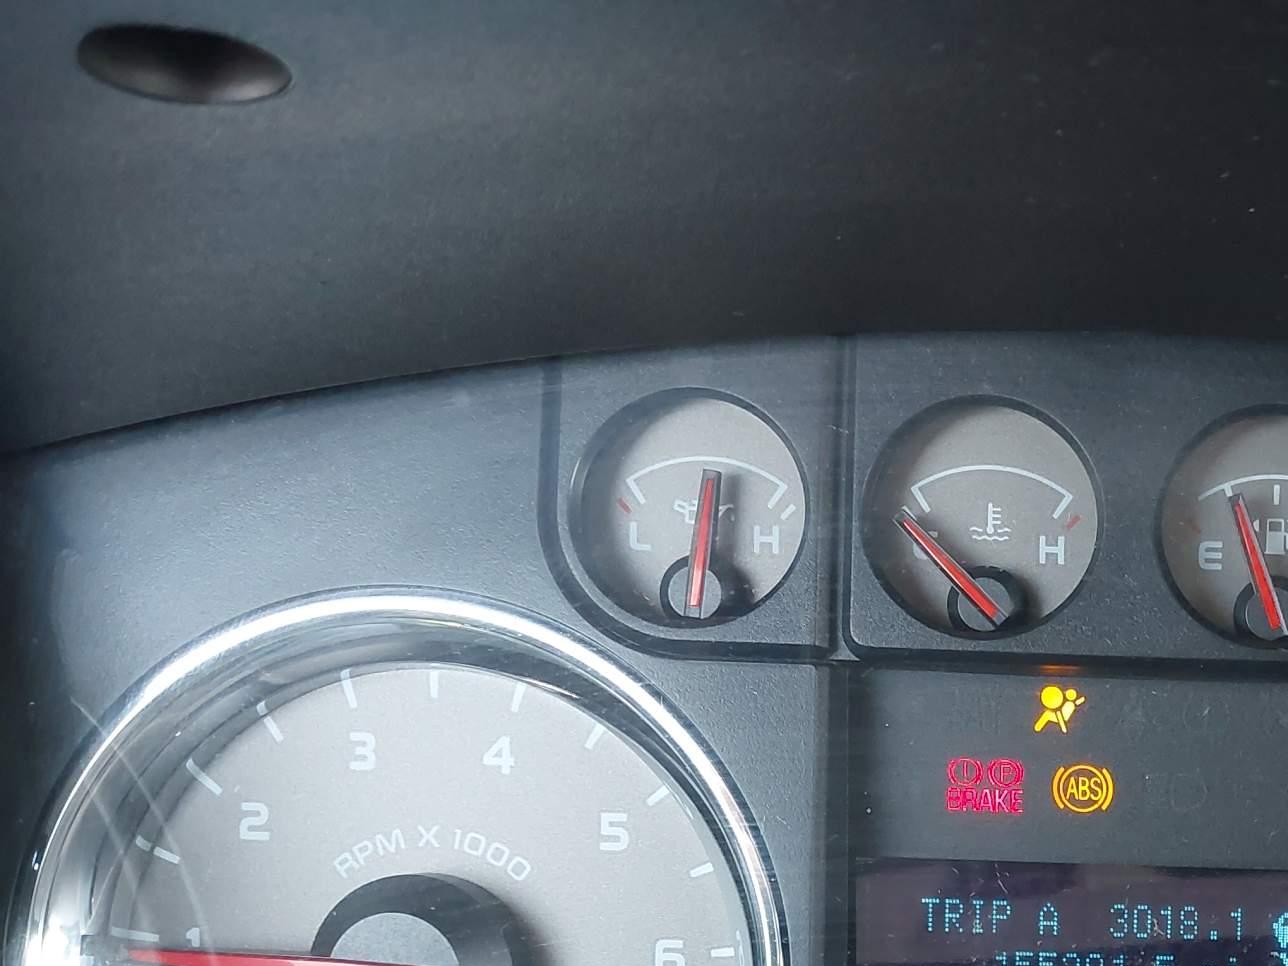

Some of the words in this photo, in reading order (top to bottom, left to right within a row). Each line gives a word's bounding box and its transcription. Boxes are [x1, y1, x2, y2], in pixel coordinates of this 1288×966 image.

[629, 522, 651, 551] L
[754, 527, 779, 554] H
[1039, 536, 1065, 565] H
[1199, 541, 1223, 570] E
[349, 733, 376, 771] 3
[483, 736, 515, 774] 4
[947, 787, 1023, 813] BRAKE
[1066, 776, 1102, 801] ABS
[239, 802, 270, 841] 2
[600, 812, 628, 852] 5
[334, 828, 405, 878] RPM
[418, 825, 440, 847] X
[454, 829, 531, 881] 1000
[921, 898, 1011, 932] TRIP
[1039, 902, 1060, 935] A
[1109, 903, 1243, 940] 3018.1
